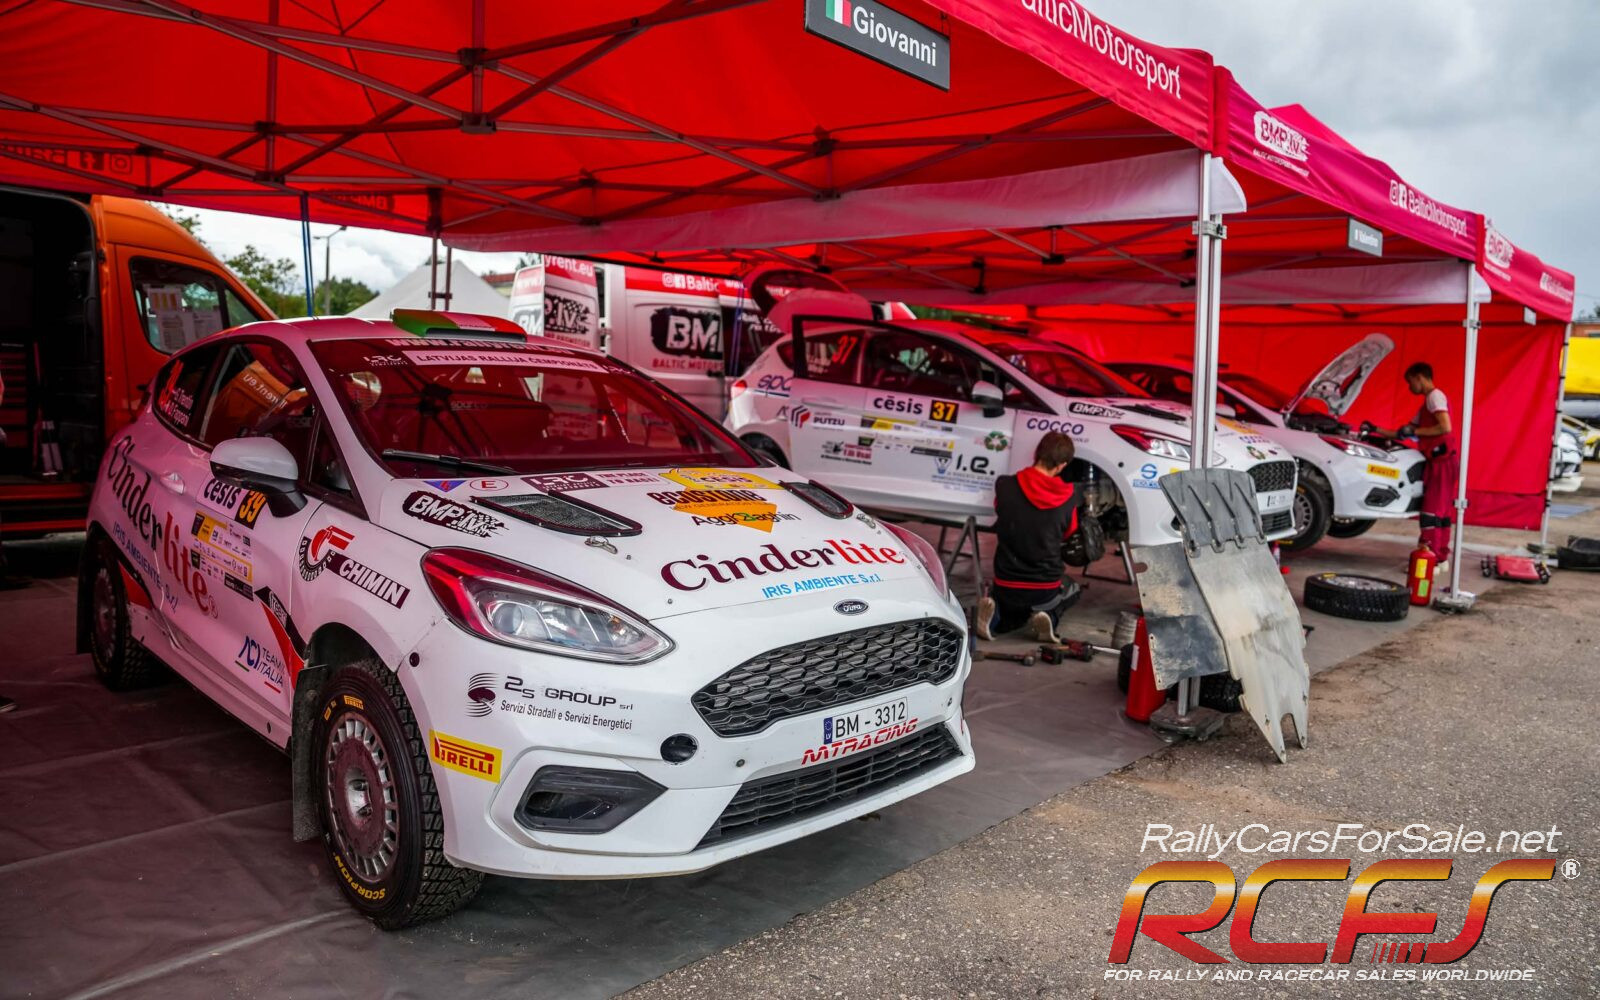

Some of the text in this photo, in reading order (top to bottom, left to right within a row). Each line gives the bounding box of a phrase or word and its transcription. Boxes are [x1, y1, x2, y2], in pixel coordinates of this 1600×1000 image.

[852, 5, 937, 67] Giovanni
[652, 357, 686, 369] BALTIC
[831, 335, 858, 365] 37
[813, 417, 845, 426] PUTZU
[873, 395, 956, 422] cēsis 37
[239, 489, 267, 523] 39
[646, 489, 768, 506] ecostone
[106, 434, 209, 613] Cinderlite
[113, 521, 127, 547] IRIS
[125, 539, 162, 591] AMBIENTE
[660, 539, 905, 592] Cinderlite
[339, 558, 407, 606] CHIMIN
[761, 583, 792, 599] IRIS
[794, 574, 858, 594] AMBIENTE
[256, 661, 285, 687] ITALIA
[500, 700, 632, 731] Servizi Stradali e Servizi Energetici
[545, 688, 617, 707] GROUP
[619, 703, 634, 711] srl
[835, 714, 860, 739] BM
[875, 702, 906, 727] 3312
[434, 736, 495, 775] PIRELLI
[801, 717, 919, 766] MTRACING
[334, 852, 387, 900] SCORPION
